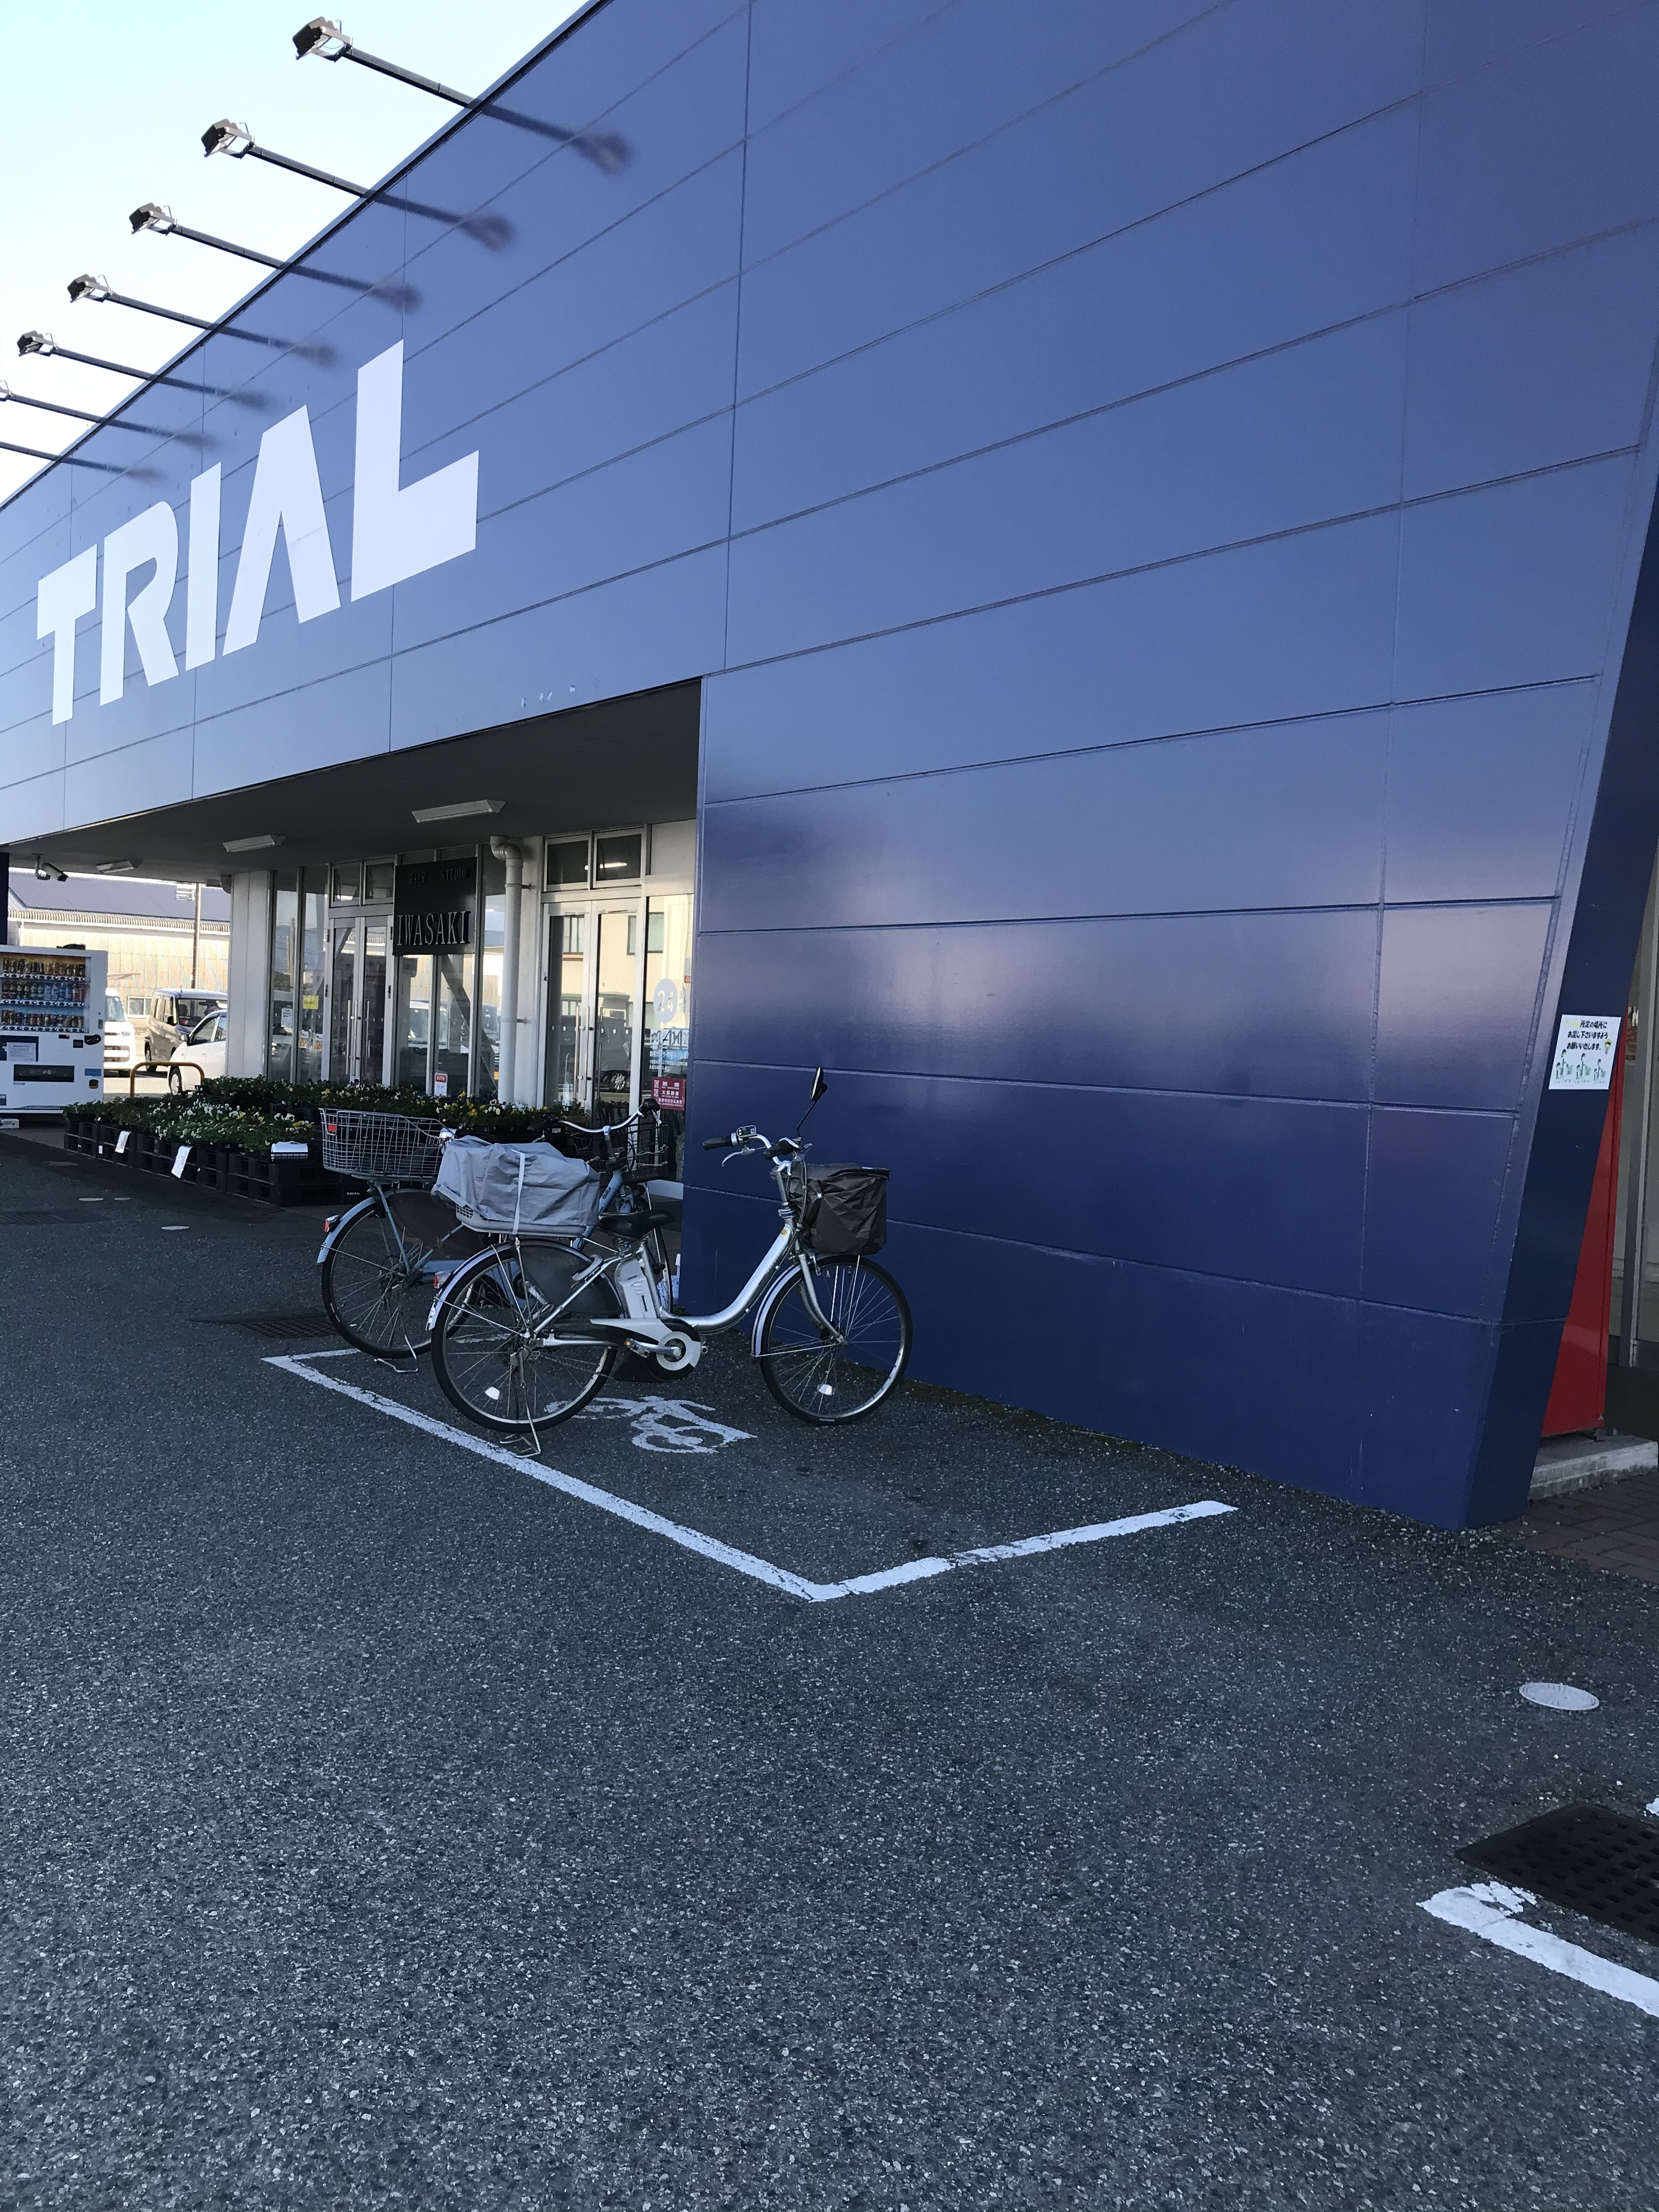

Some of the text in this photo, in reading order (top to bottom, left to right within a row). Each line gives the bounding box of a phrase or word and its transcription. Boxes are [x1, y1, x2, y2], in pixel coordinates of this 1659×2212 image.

[37, 339, 479, 726] TRIAL
[409, 868, 467, 884] HAIR STUDIO
[397, 911, 466, 945] IWASAKI
[656, 990, 674, 1012] 24
